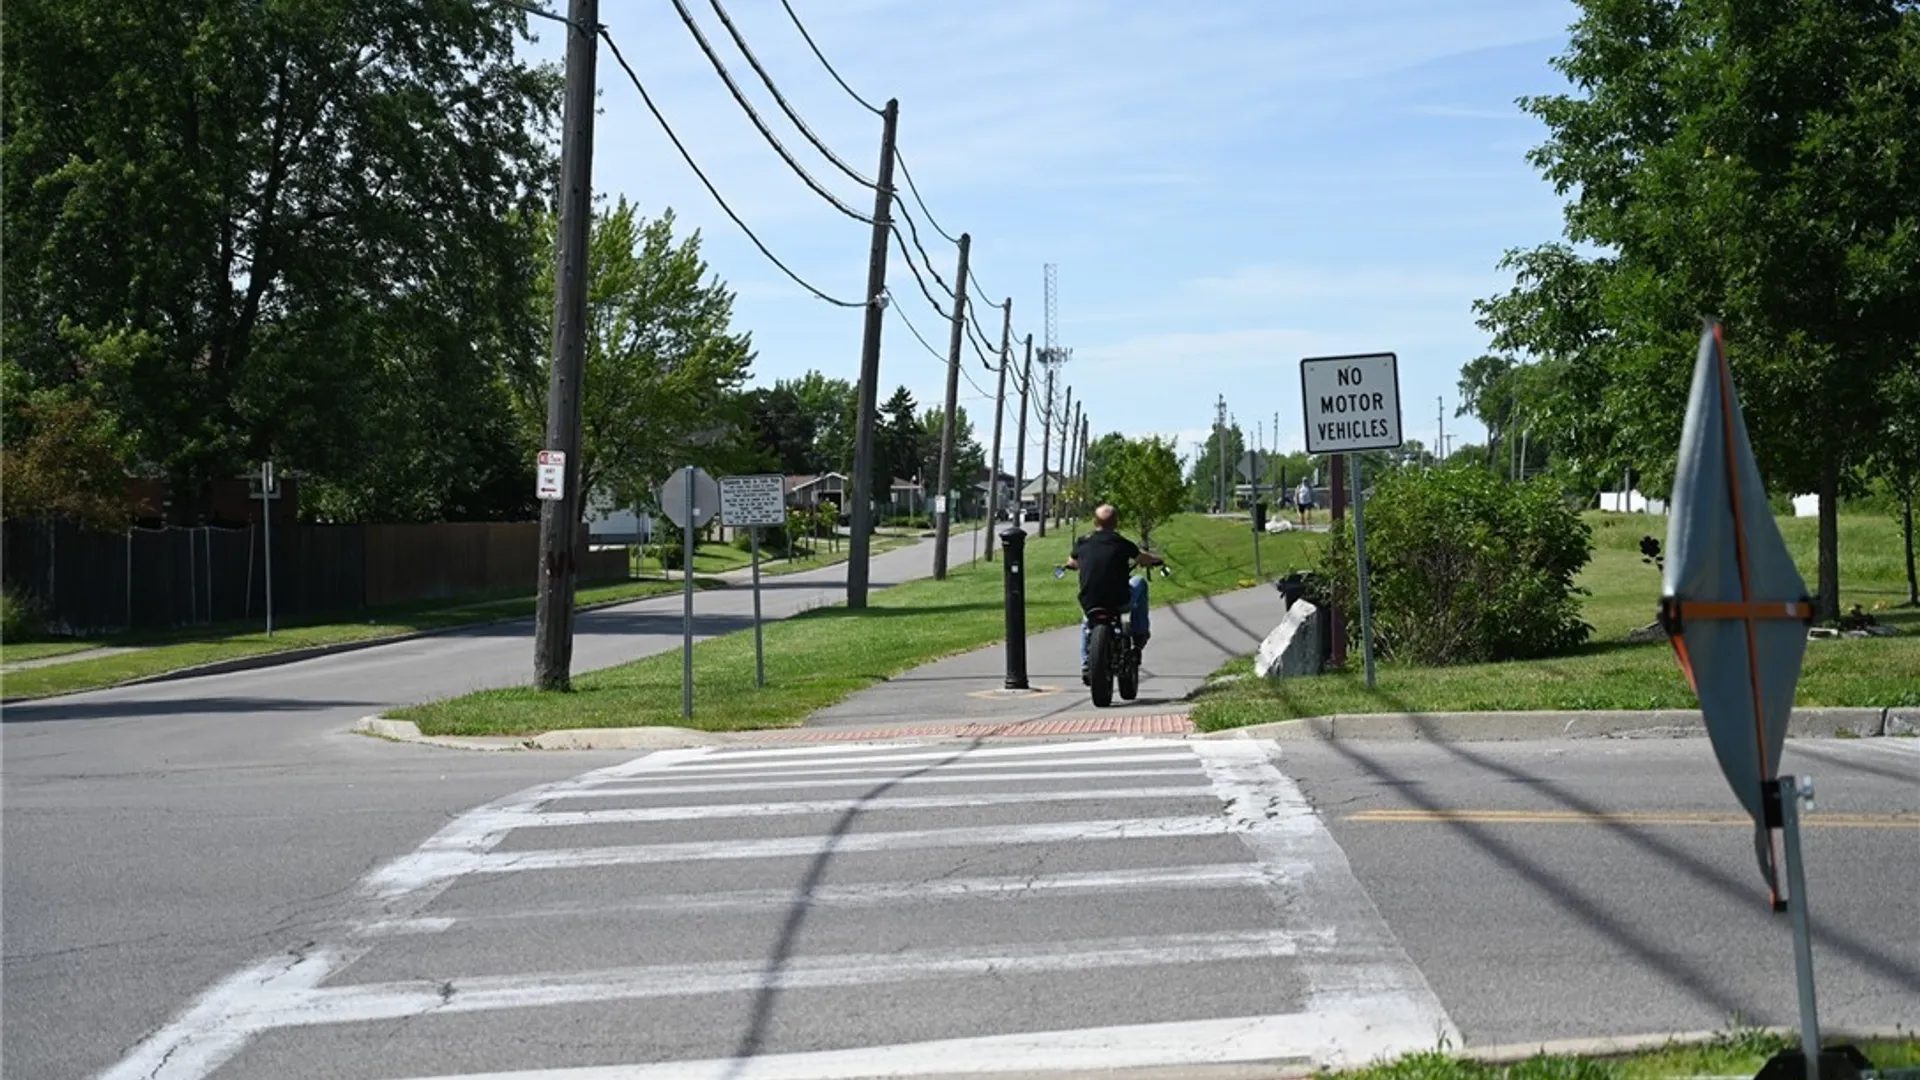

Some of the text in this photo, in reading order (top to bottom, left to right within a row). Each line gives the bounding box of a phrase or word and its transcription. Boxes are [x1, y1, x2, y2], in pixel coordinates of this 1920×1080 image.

[1337, 367, 1362, 386] NO
[1320, 392, 1384, 414] MOTOR
[1317, 418, 1388, 440] VEHICLES
